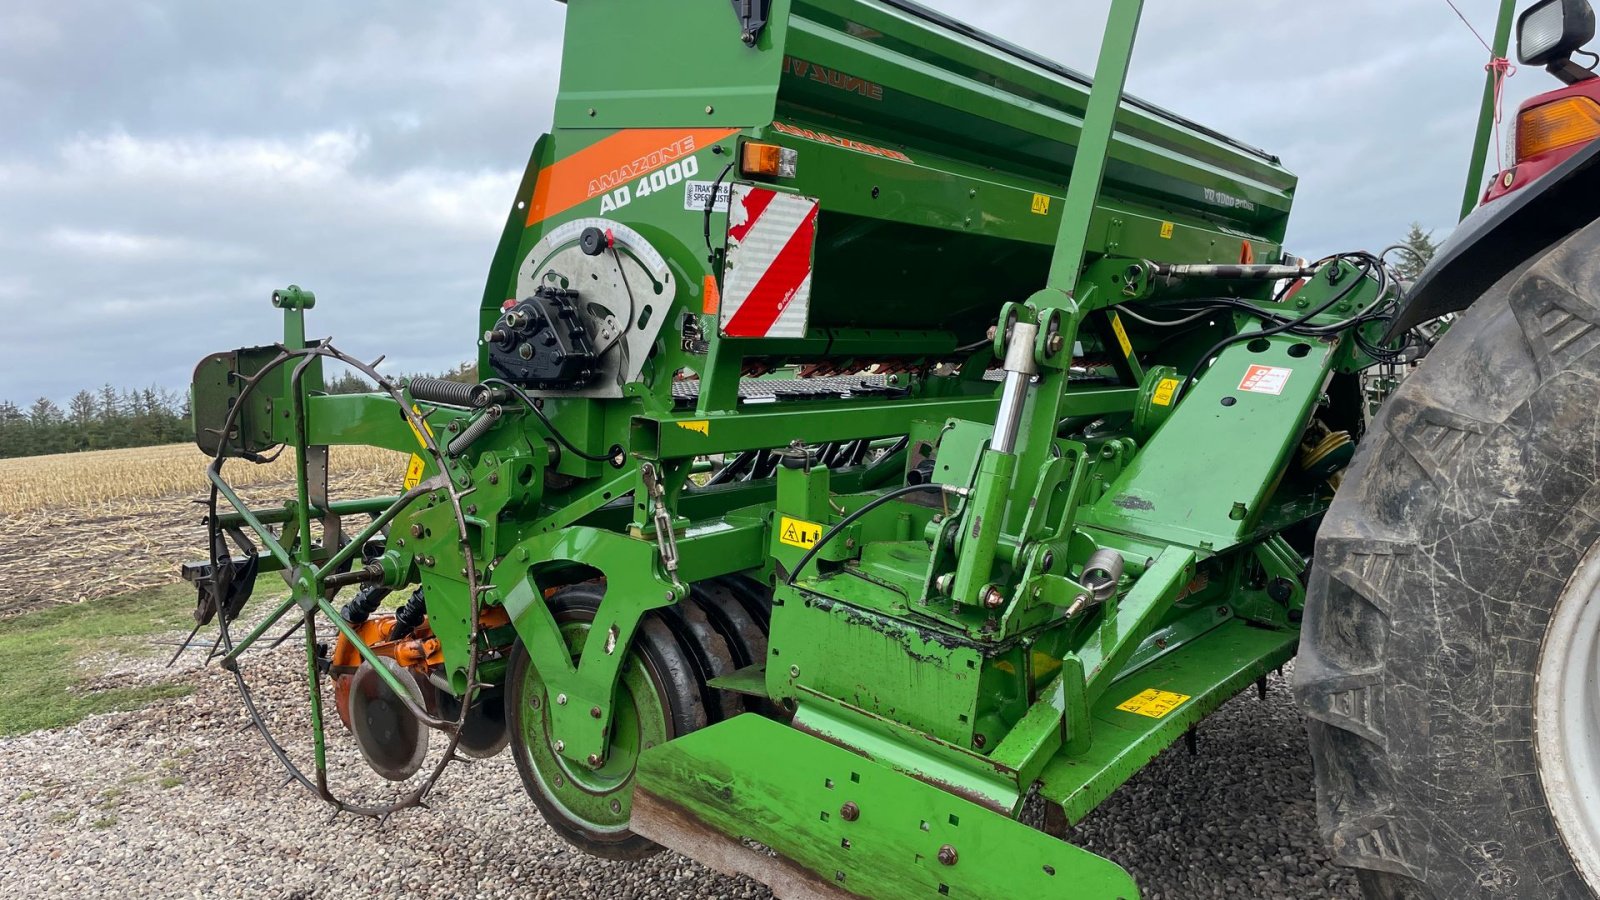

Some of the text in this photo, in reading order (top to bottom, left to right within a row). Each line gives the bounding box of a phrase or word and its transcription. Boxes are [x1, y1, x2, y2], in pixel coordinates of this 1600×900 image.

[587, 135, 695, 198] AMAZONE
[600, 185, 631, 216] AD
[636, 155, 699, 198] 4000
[694, 185, 729, 194] TRAKR &
